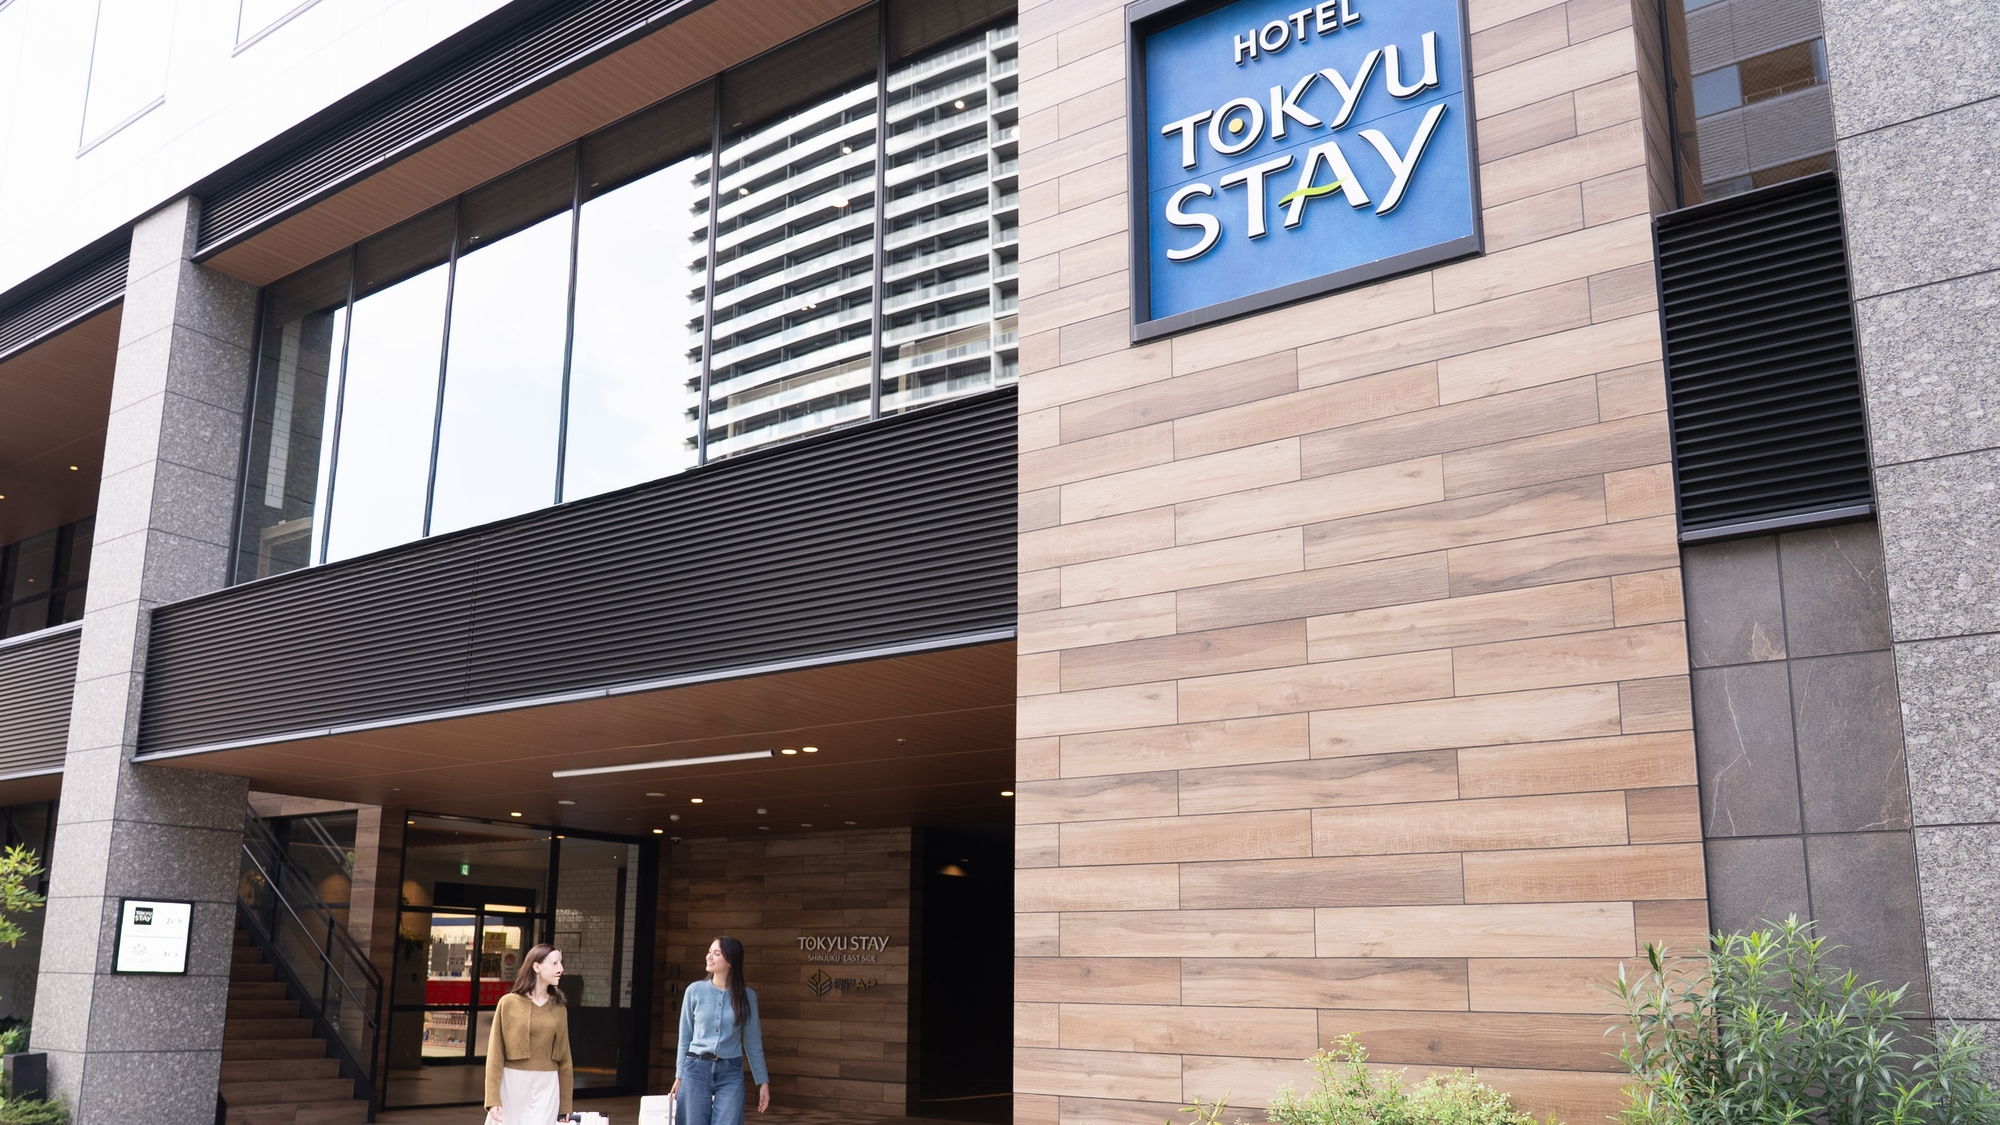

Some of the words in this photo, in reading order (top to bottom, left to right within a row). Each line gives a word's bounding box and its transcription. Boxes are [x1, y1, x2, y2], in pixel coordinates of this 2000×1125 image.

[1234, 0, 1361, 66] HOTEL
[1161, 31, 1440, 171] TOKYU
[1165, 103, 1449, 262] STAY
[797, 936, 847, 952] TOKYU
[850, 936, 890, 952] STAY
[861, 954, 876, 962] SIDE
